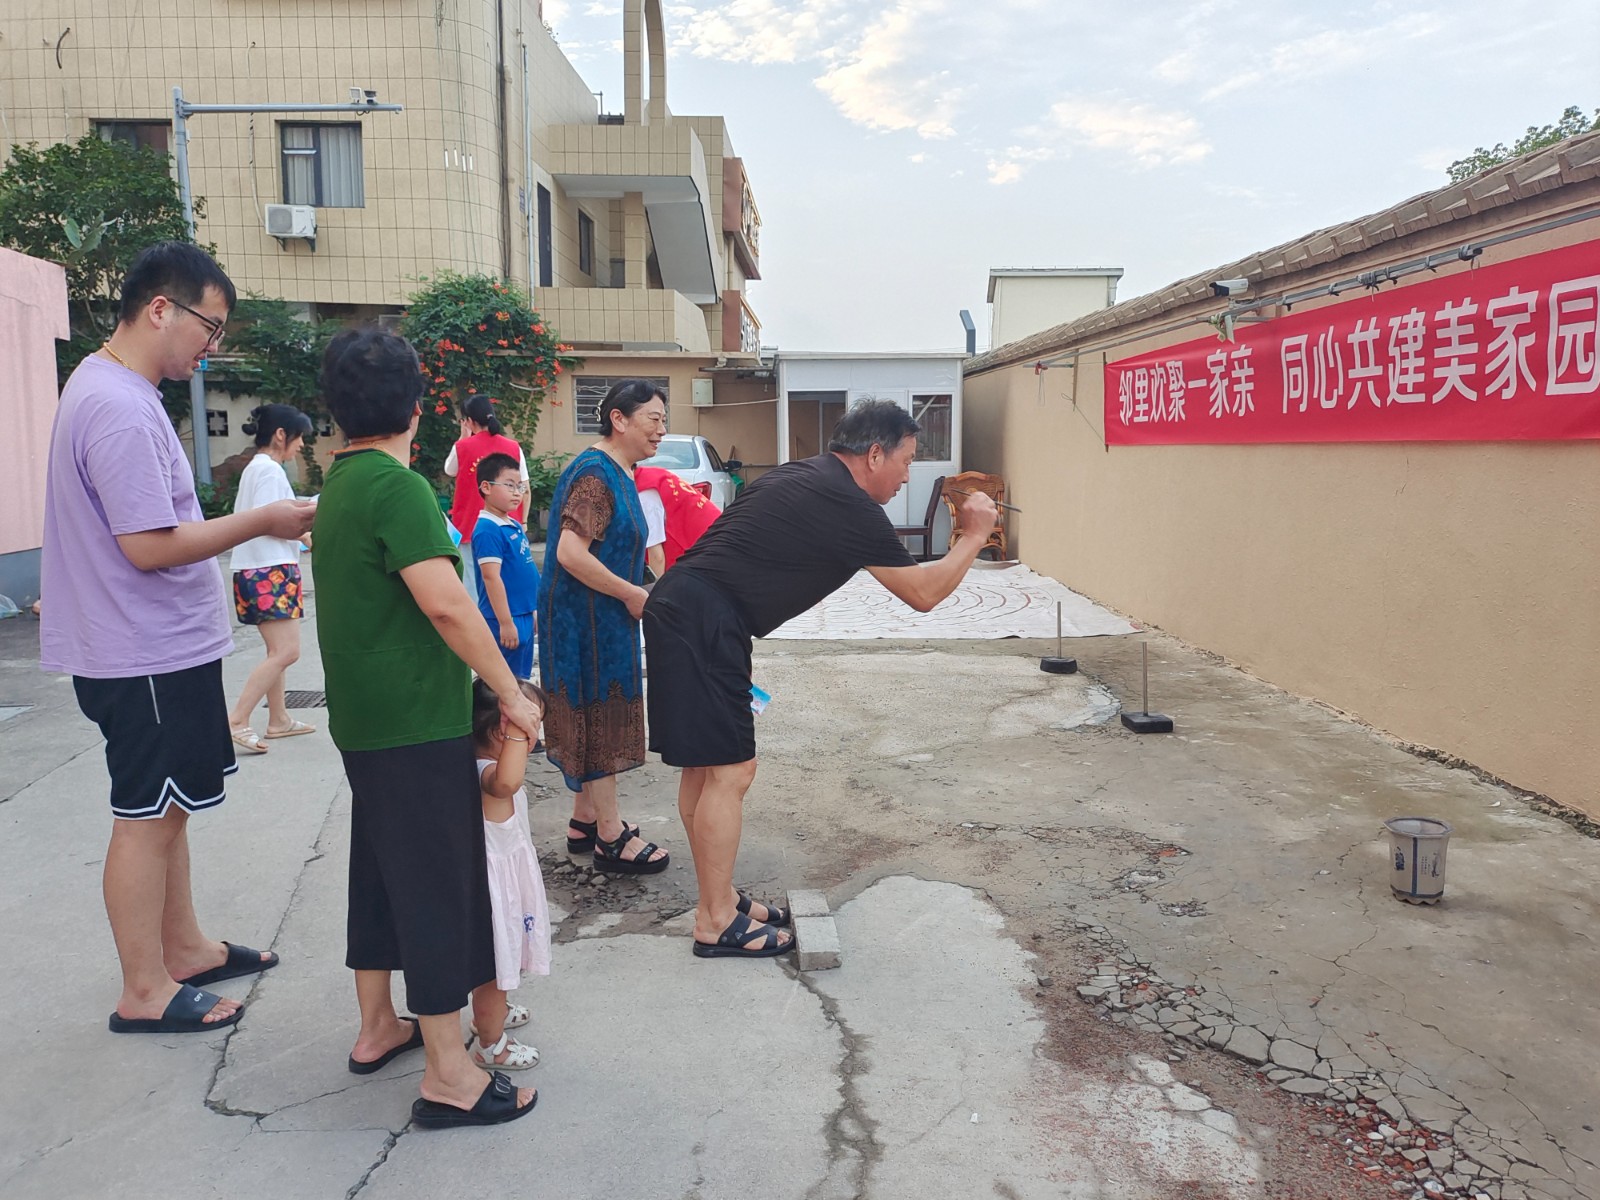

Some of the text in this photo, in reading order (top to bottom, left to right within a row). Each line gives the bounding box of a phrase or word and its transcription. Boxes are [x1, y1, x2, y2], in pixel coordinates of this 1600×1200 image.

[1118, 274, 1600, 426] 邻里欢聚一家亲 同心共建美家园
